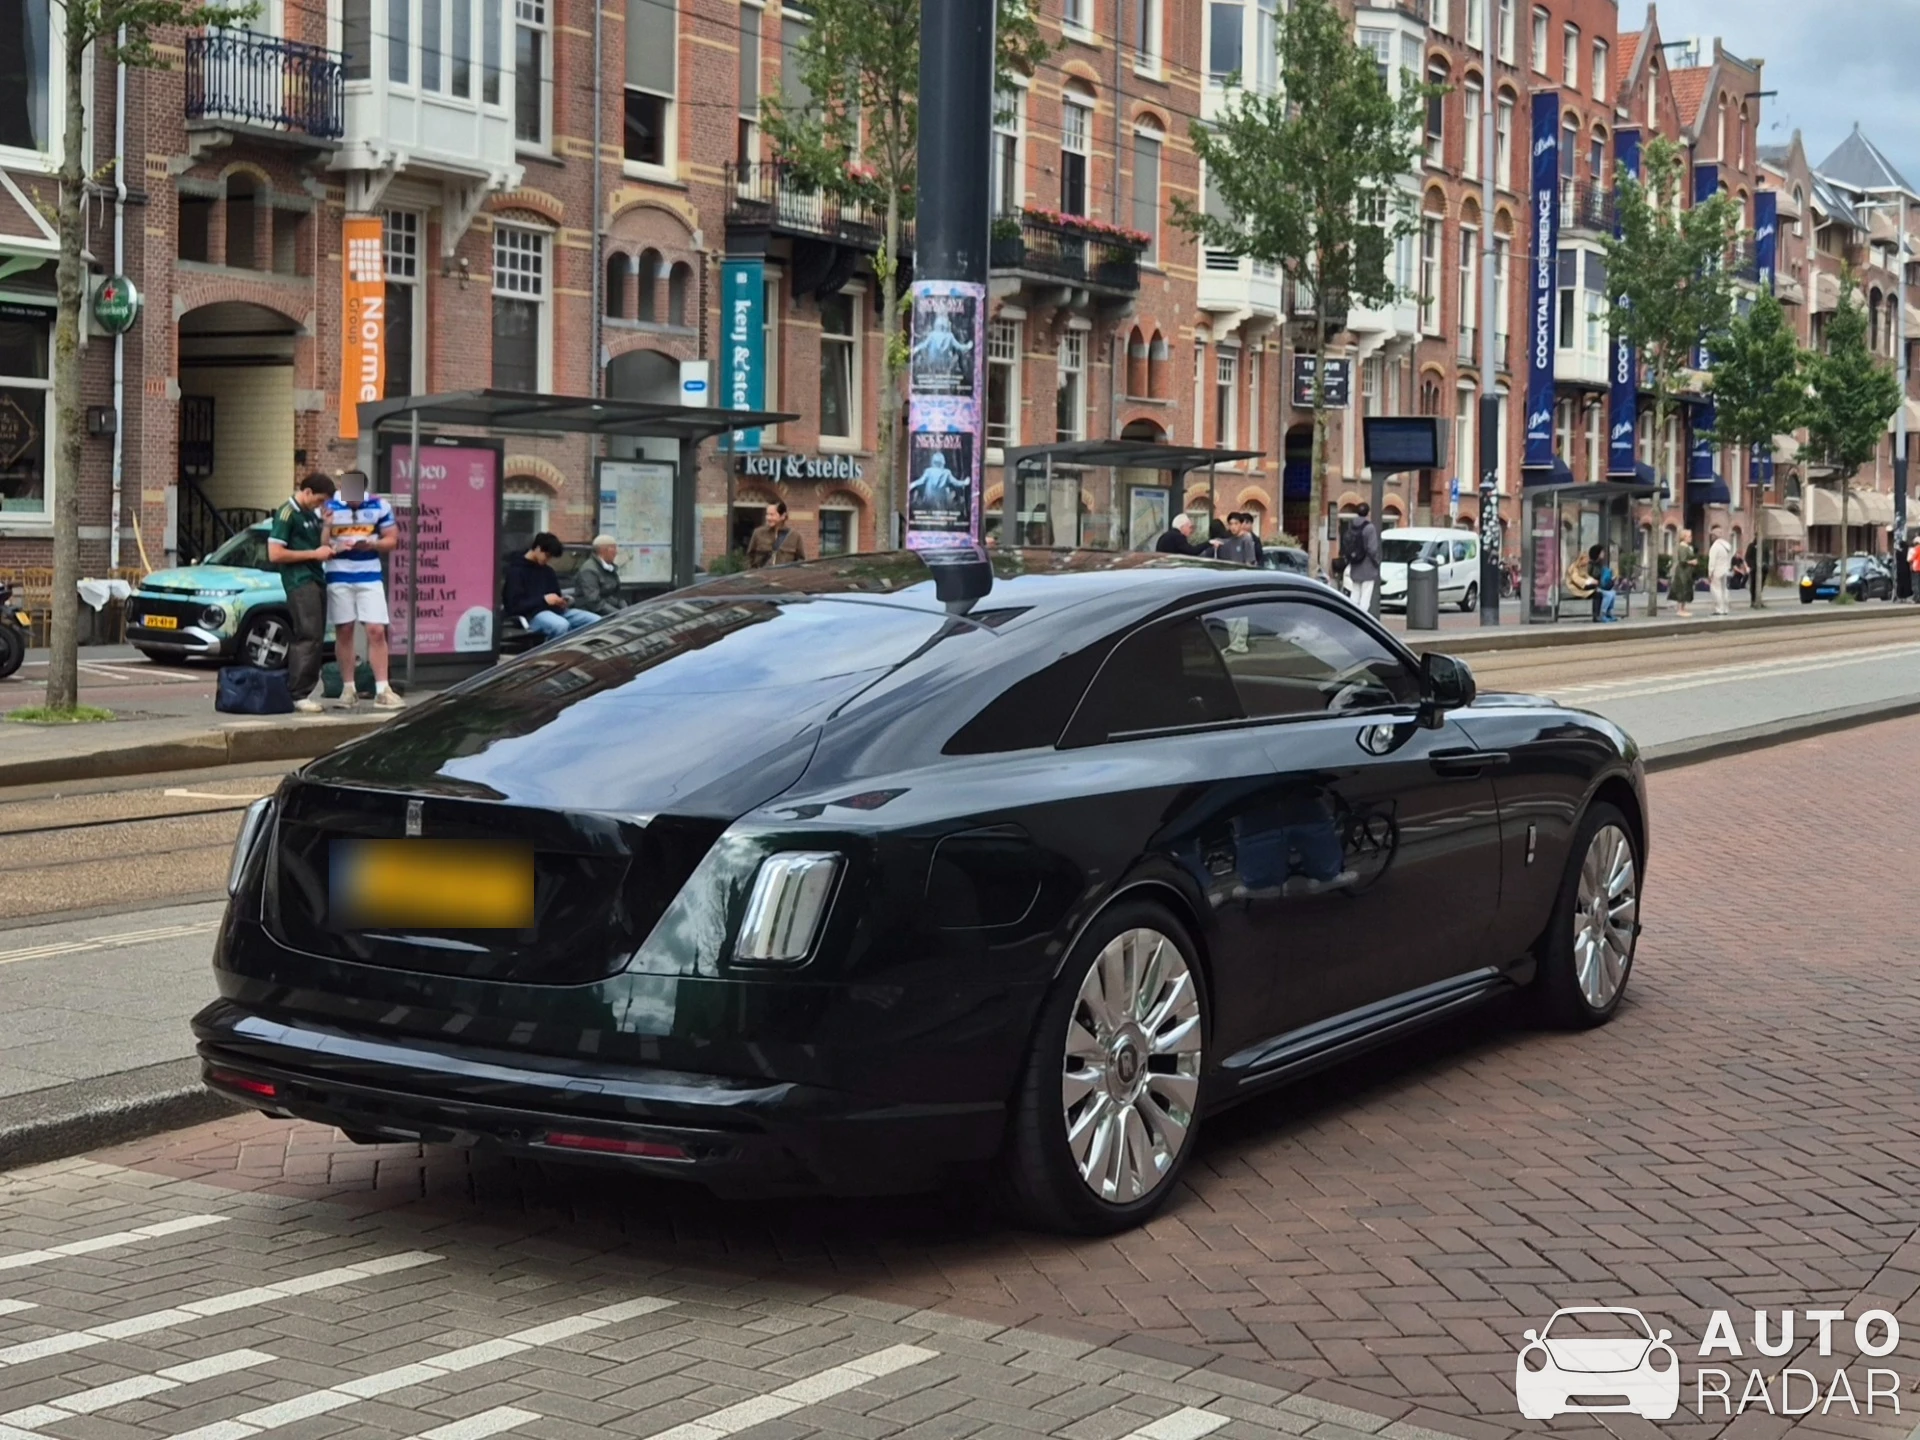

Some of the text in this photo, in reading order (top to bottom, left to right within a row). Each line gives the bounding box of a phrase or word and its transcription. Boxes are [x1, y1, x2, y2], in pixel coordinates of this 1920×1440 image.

[1536, 189, 1550, 370] COCKTAIL EXPERIENCE
[348, 298, 359, 345] Group
[730, 299, 752, 341] keij
[361, 296, 383, 402] Norme
[733, 346, 751, 372] &
[733, 371, 750, 442] stefs
[745, 454, 863, 484] keij & stefels
[439, 589, 457, 601] Art
